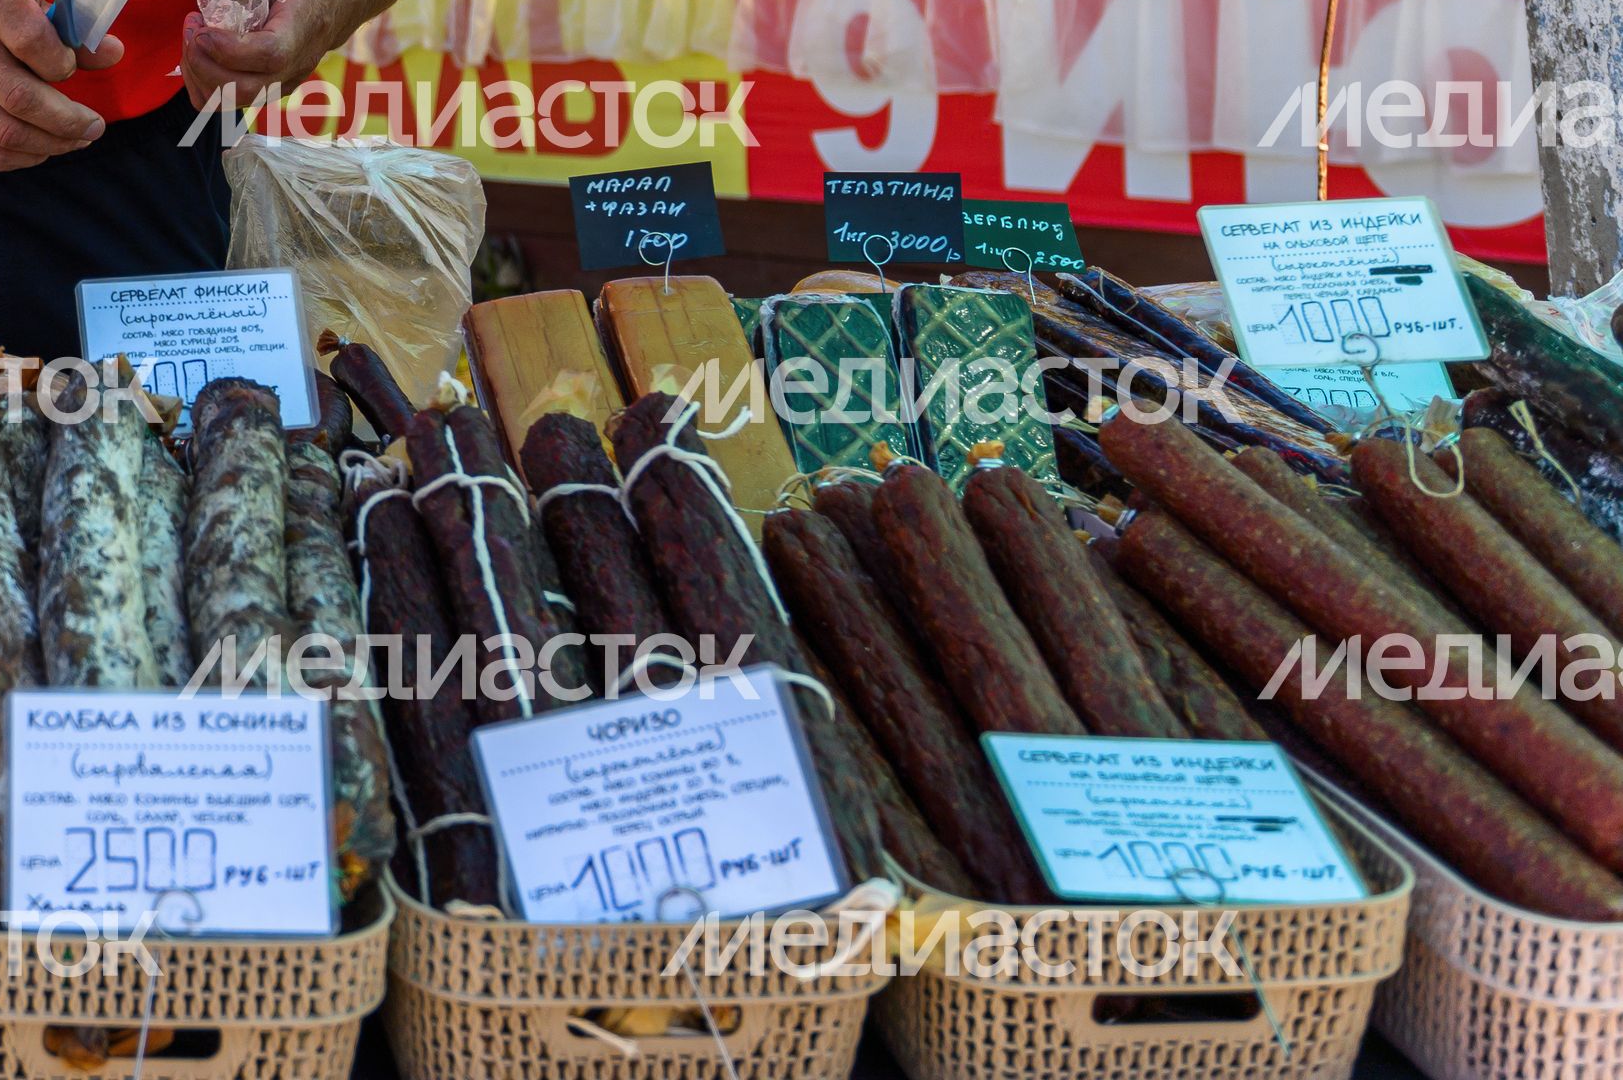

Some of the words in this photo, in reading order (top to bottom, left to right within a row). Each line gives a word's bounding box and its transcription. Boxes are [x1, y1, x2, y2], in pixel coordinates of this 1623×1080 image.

[826, 180, 954, 201] ТЕЛЯТИНА
[1221, 220, 1301, 238] СЕРВЕЛАТ
[1310, 219, 1333, 232] ИЗ
[1340, 211, 1421, 230] ИНДЕЙКИ
[1263, 241, 1280, 251] НА
[1285, 235, 1349, 249] ОЛЬХОВОЙ
[1356, 233, 1389, 245] ЩЕПЕ
[110, 286, 188, 303] СЕРВЕЛАТ
[194, 280, 269, 299] ФИНСКИЙ
[120, 298, 267, 328] (сырокопчёный)
[1248, 323, 1277, 334] ЦЕНА
[1278, 296, 1390, 343] 1000
[122, 331, 157, 340] СОСТАВ:
[161, 329, 184, 338] МЯСО
[188, 326, 238, 336] ГОВЯДИНЫ
[154, 339, 177, 348] МЯСО
[180, 337, 217, 347] КУРИЦЫ
[221, 336, 239, 344] 20%
[214, 345, 246, 354] СМЕСЬ,
[27, 709, 139, 732] КОЛБАСА
[153, 711, 186, 730] ИЗ
[198, 710, 308, 732] КОНИНЫ
[586, 707, 682, 743] ЧОРИЗО
[1018, 748, 1121, 765] СЕРВЕЛАТ
[1132, 754, 1162, 768] ИЗ
[1171, 754, 1276, 772] ИНДЕЙКИ
[1070, 770, 1092, 780] НА
[1097, 769, 1186, 785] ВИШНЕВОЙ
[20, 856, 61, 870] ЦЕНА
[64, 827, 217, 894] 2500
[528, 882, 568, 902] ЦЕНА
[571, 826, 717, 913] 1000
[1097, 840, 1239, 882] 1000
